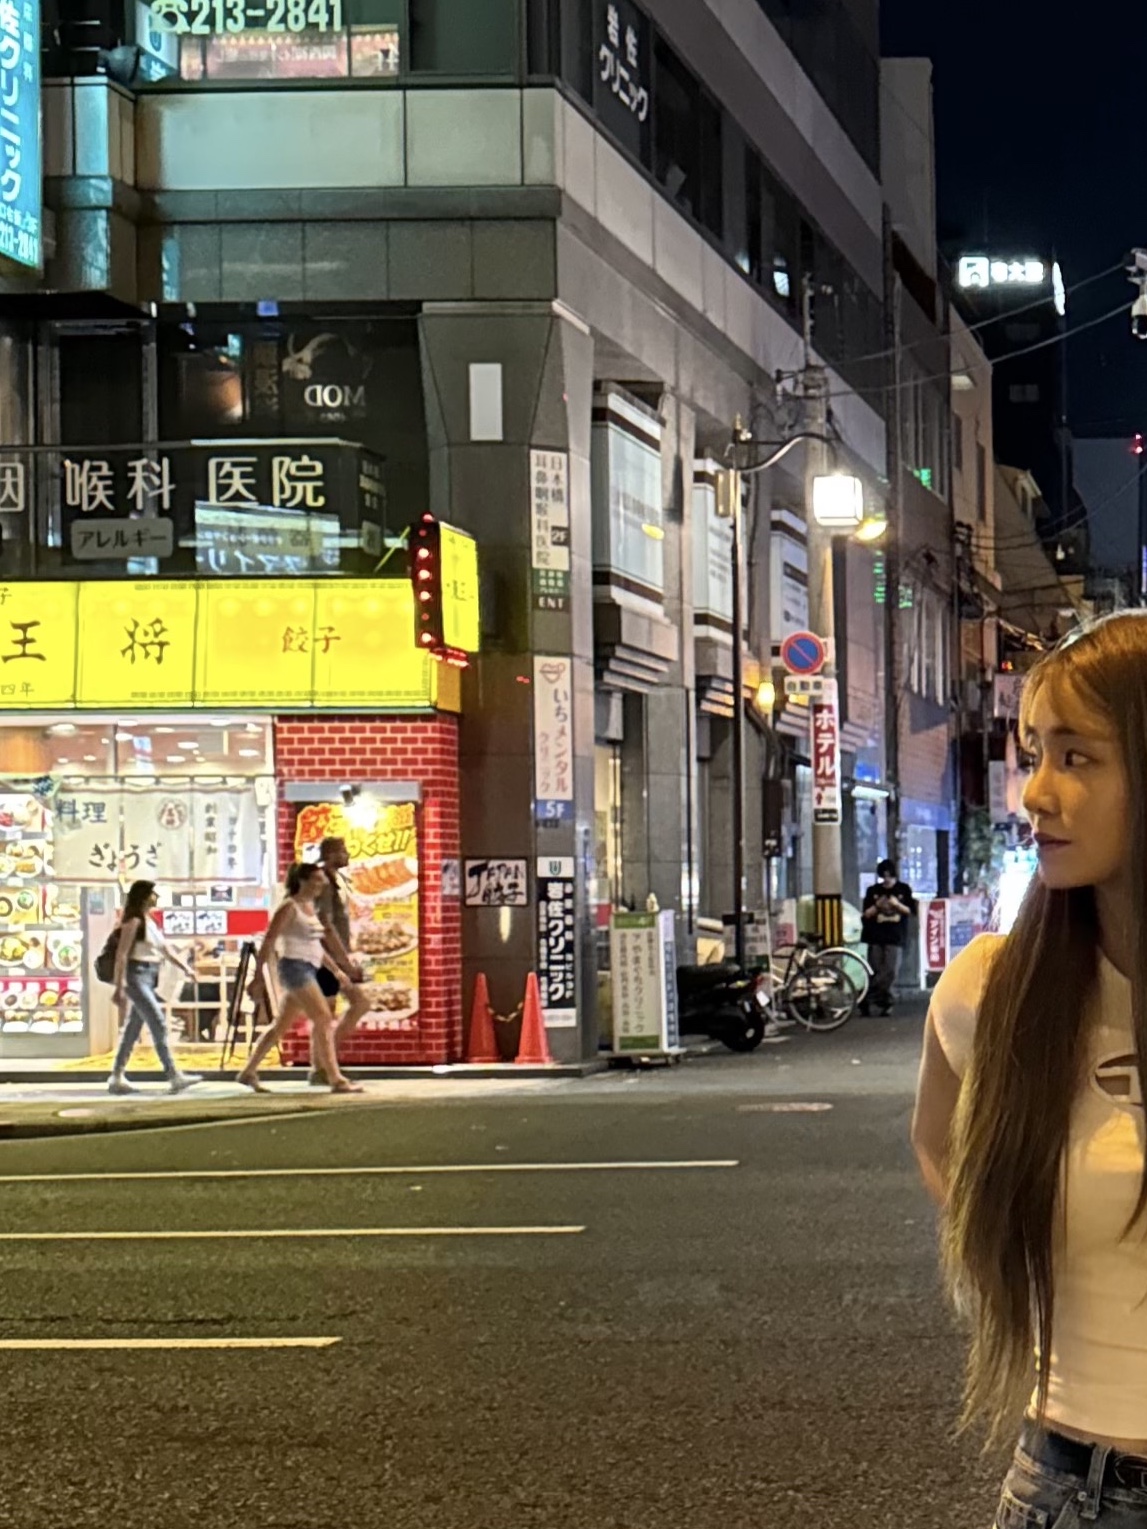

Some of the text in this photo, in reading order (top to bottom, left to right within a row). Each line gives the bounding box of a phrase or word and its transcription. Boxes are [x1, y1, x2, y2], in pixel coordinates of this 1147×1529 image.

[190, 0, 342, 34] 213-2841
[599, 43, 648, 122] クリニック
[77, 531, 169, 549] アレルギー
[551, 530, 568, 542] 2F
[538, 597, 564, 609] ENT
[282, 626, 341, 654] 餃子
[816, 711, 835, 776] ホテル
[55, 799, 107, 824] 料理
[545, 801, 566, 817] 5F
[88, 842, 162, 873] ぎょうざ
[547, 881, 565, 1001] 岩佐クリニック
